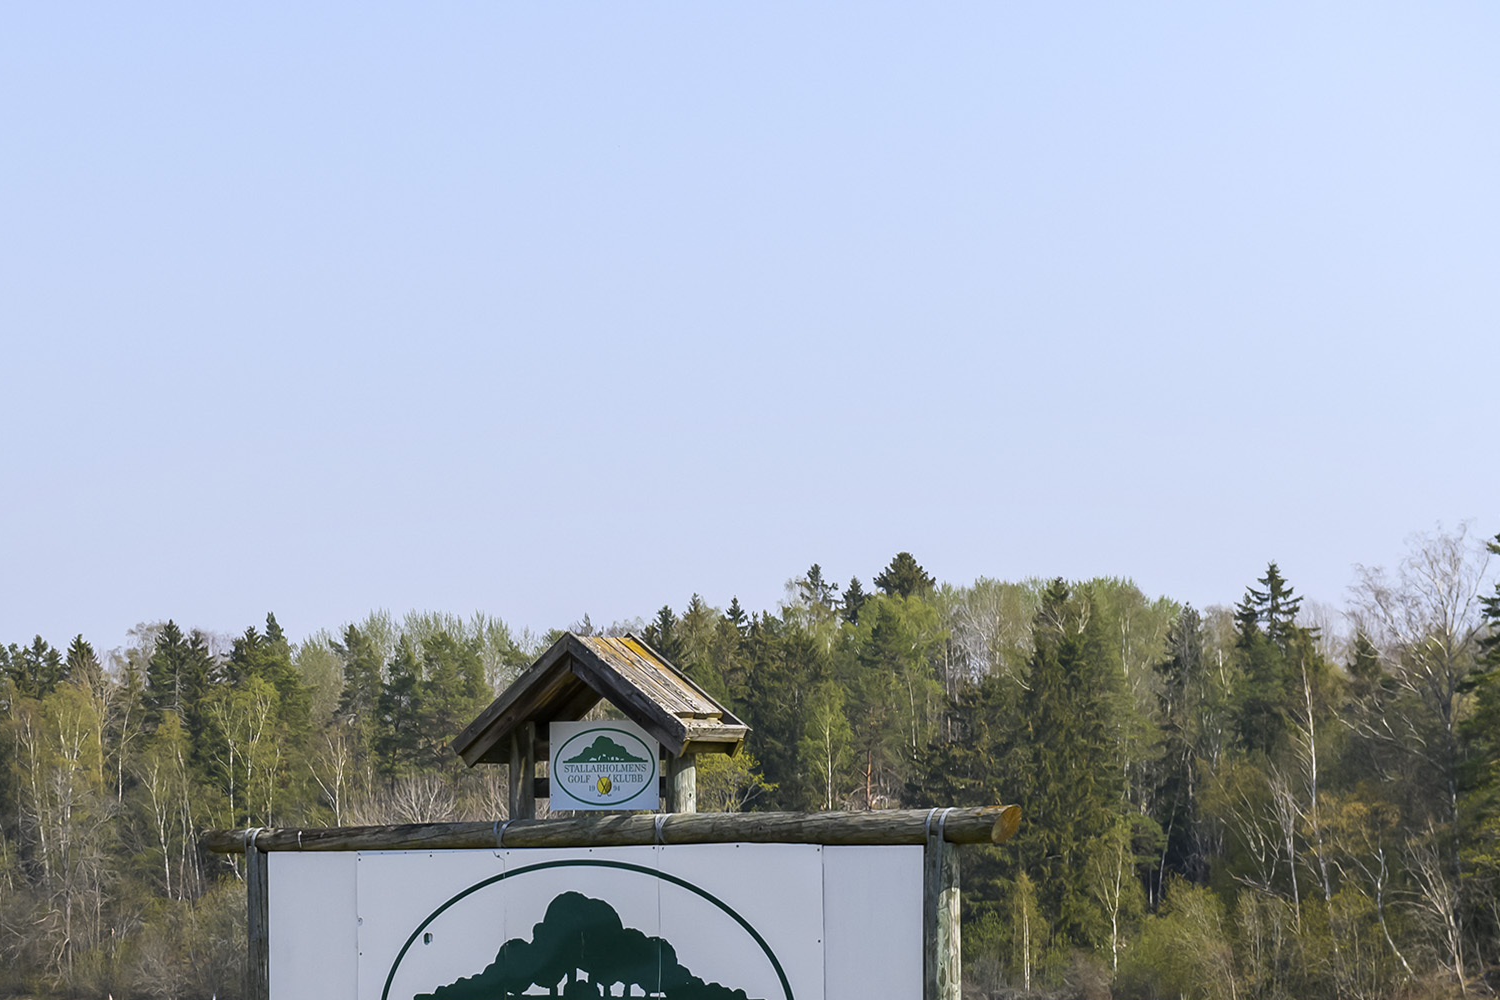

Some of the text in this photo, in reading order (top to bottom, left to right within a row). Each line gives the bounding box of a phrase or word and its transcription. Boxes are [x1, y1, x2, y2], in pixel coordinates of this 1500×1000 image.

[564, 764, 647, 773] STALLARHOLMENS
[567, 774, 643, 783] GOLF KLUBB
[588, 784, 621, 792] 19 94
